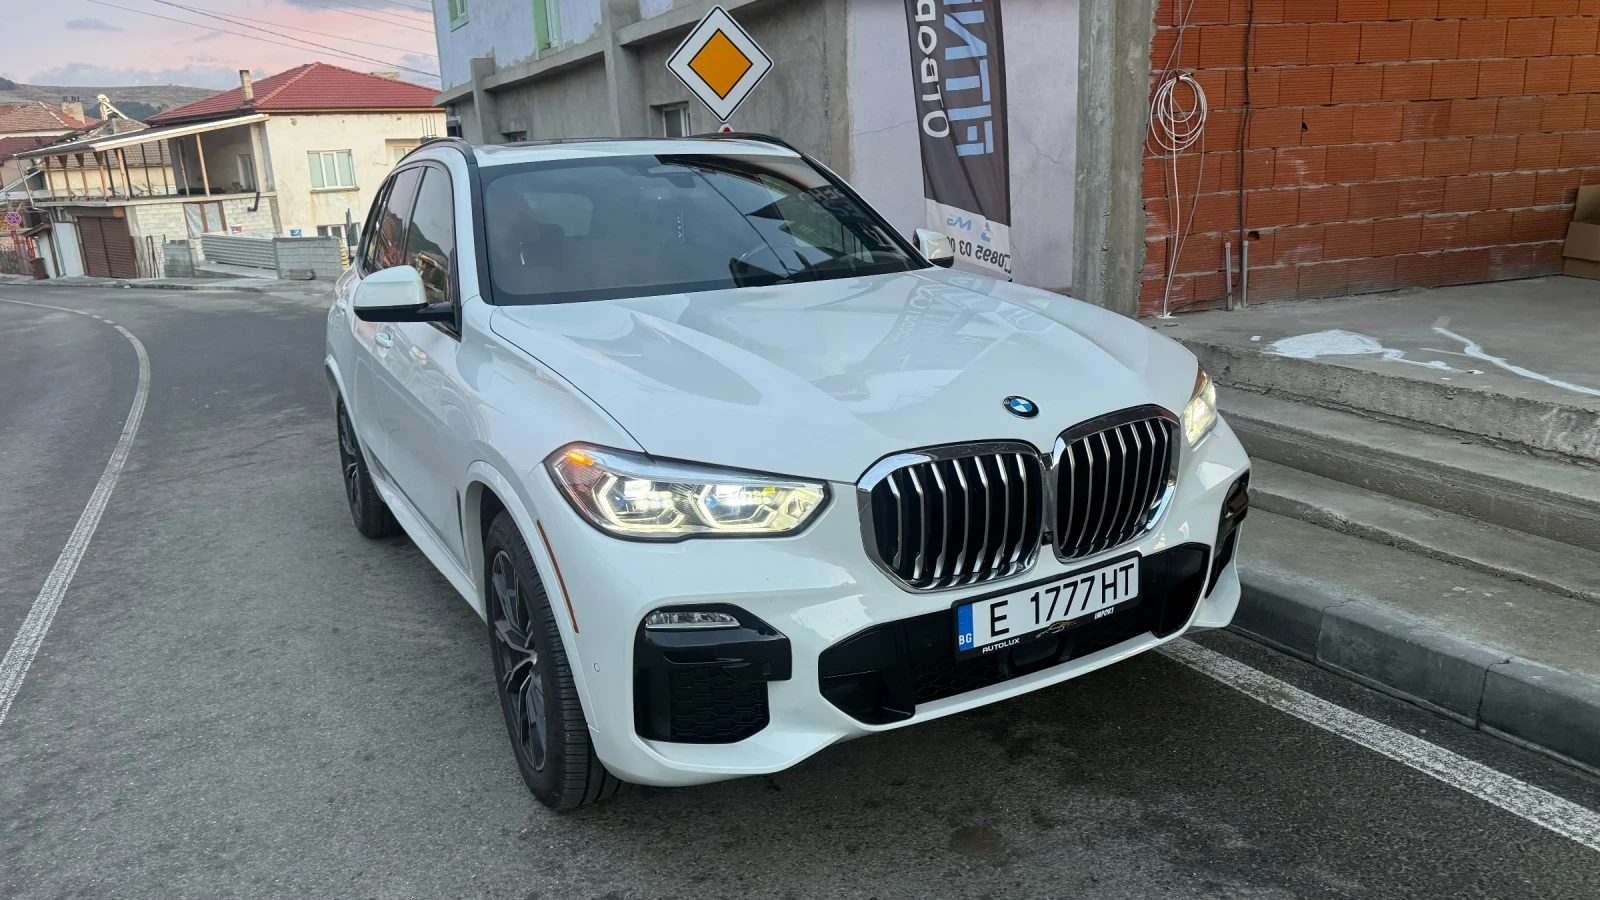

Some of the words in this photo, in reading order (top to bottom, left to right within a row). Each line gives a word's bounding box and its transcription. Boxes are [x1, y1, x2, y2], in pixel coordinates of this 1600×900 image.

[990, 600, 1009, 637] E
[1030, 575, 1095, 625] 1777
[1101, 563, 1134, 604] HT
[958, 633, 973, 646] BG
[982, 637, 1020, 654] AUTOLUX
[1094, 606, 1115, 620] IMPORT
